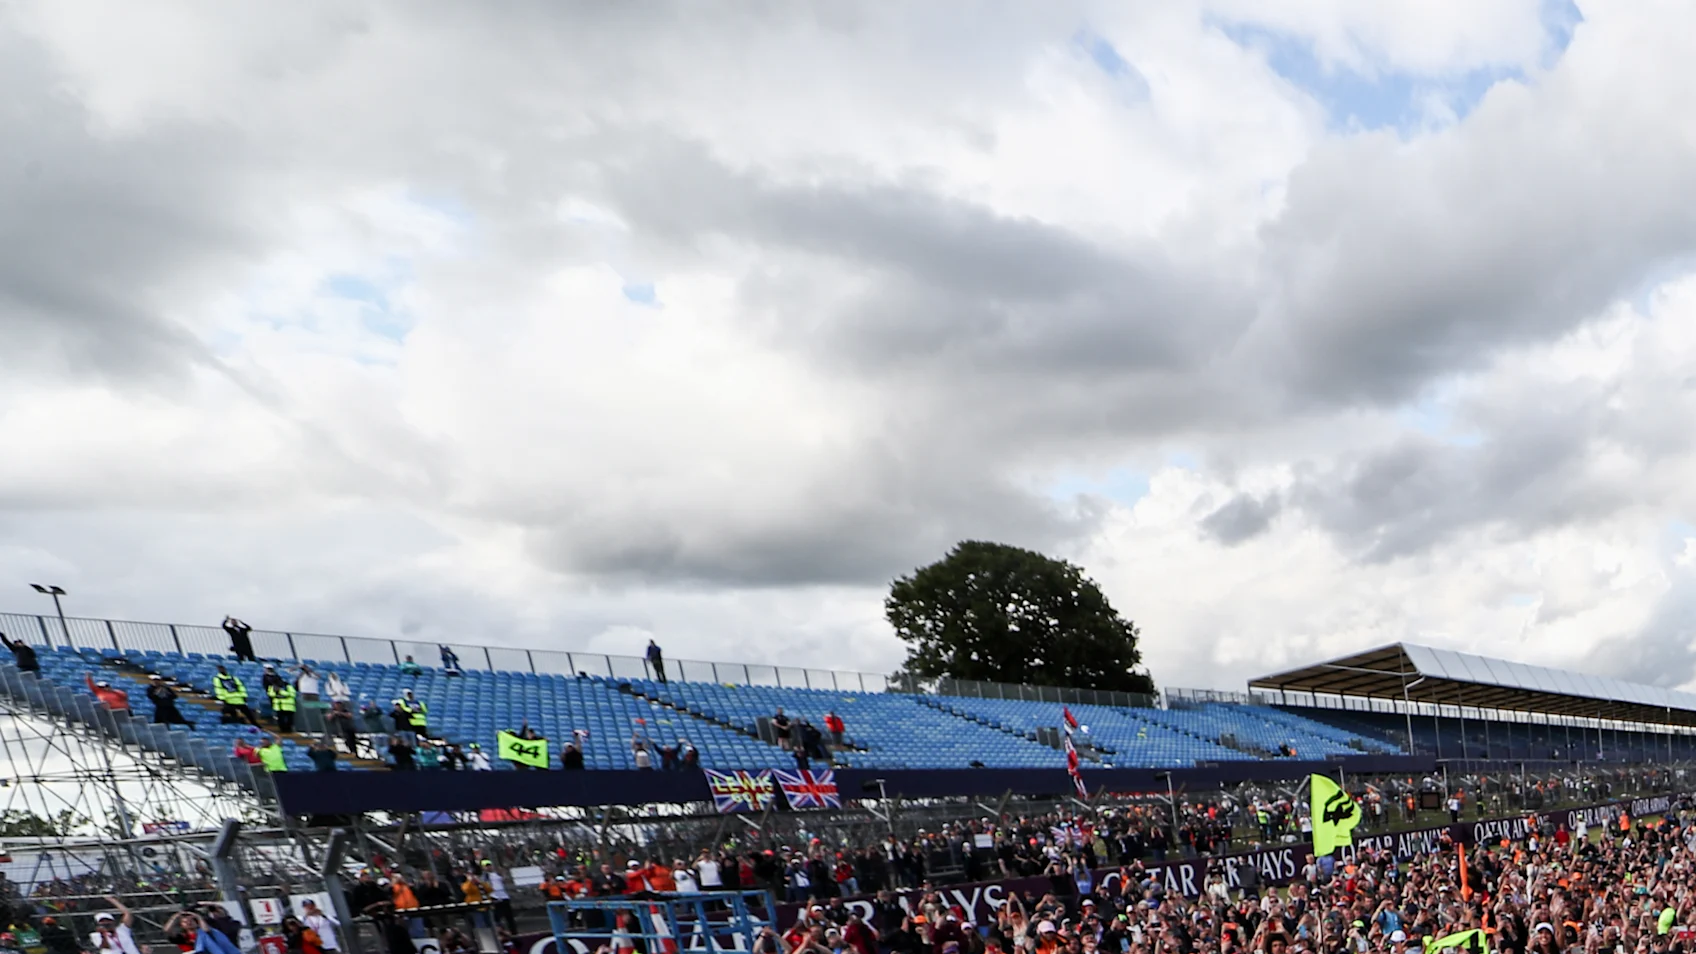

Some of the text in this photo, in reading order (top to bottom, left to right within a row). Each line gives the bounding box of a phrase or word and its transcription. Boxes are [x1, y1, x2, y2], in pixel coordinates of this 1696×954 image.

[509, 742, 540, 759] 44
[712, 775, 775, 793] LEWIS
[1474, 819, 1511, 844] QATAR
